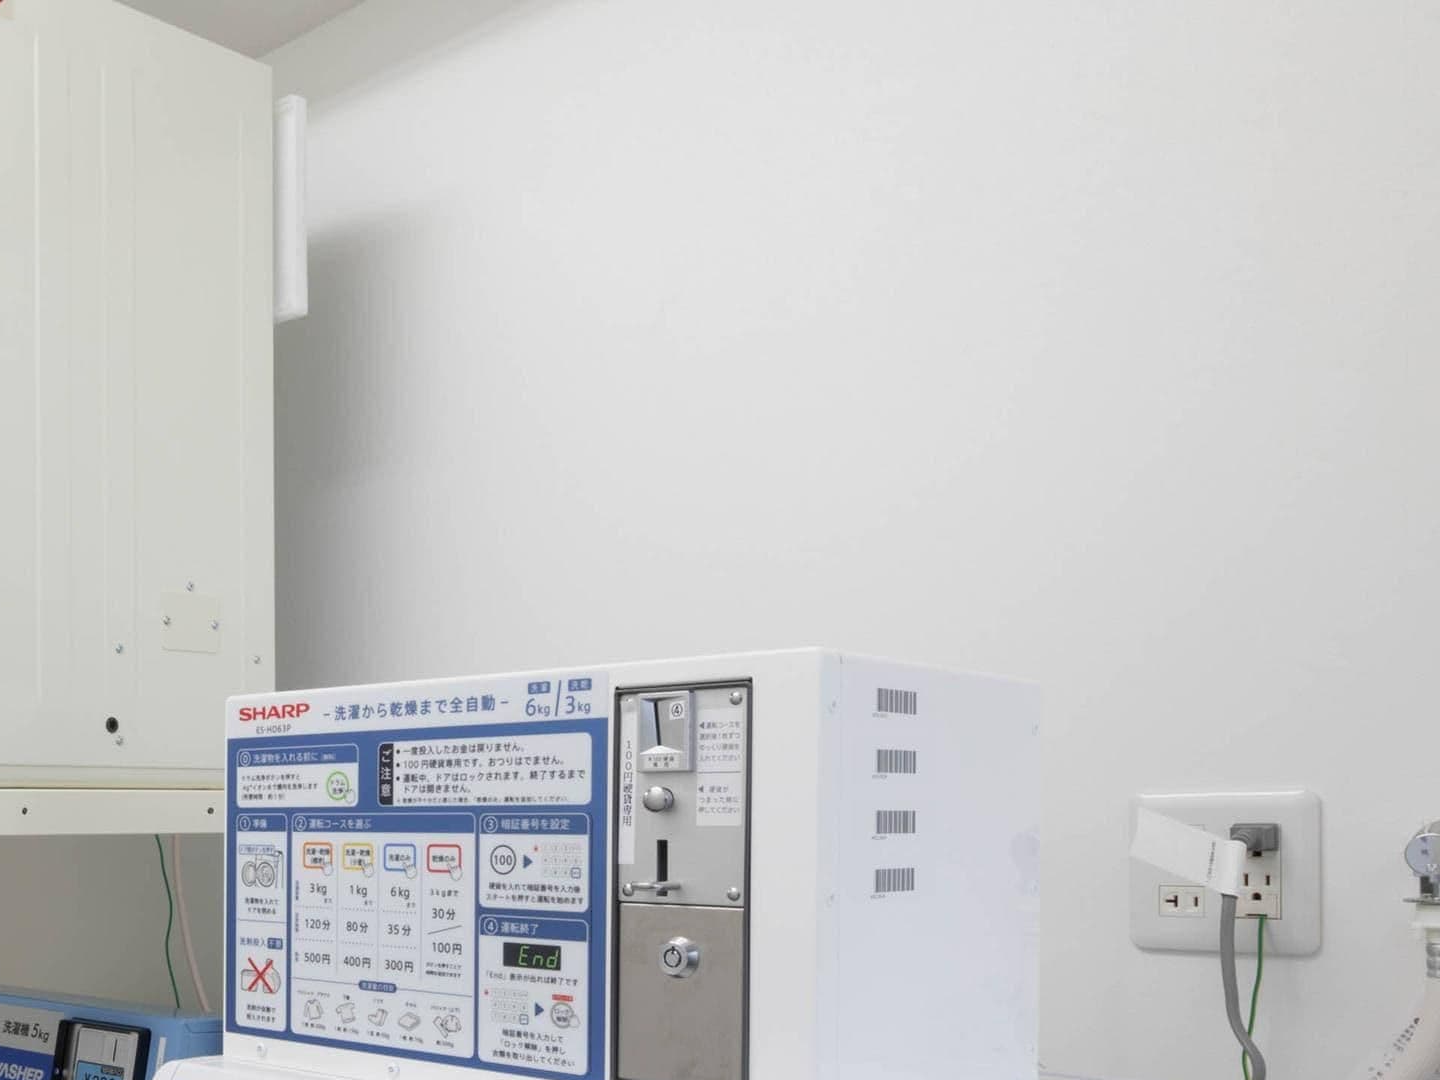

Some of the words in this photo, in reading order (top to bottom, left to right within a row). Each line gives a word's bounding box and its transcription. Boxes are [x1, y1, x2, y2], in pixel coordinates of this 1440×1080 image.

[239, 703, 310, 721] SHARP
[525, 698, 550, 716] 6kg
[565, 695, 591, 714] 3kg
[494, 855, 512, 866] 100
[310, 883, 327, 896] 3kg
[349, 884, 367, 897] 1kg
[390, 886, 410, 900] 6kg
[432, 908, 455, 921] 30分
[305, 919, 331, 930] 120分
[346, 922, 368, 934] 80分
[387, 924, 411, 936] 35分
[432, 942, 462, 956] 100円
[304, 953, 331, 965] 500円
[343, 956, 371, 969] 400円
[518, 945, 559, 968] End
[385, 959, 414, 972] 300円
[31, 1023, 50, 1043] 5kg
